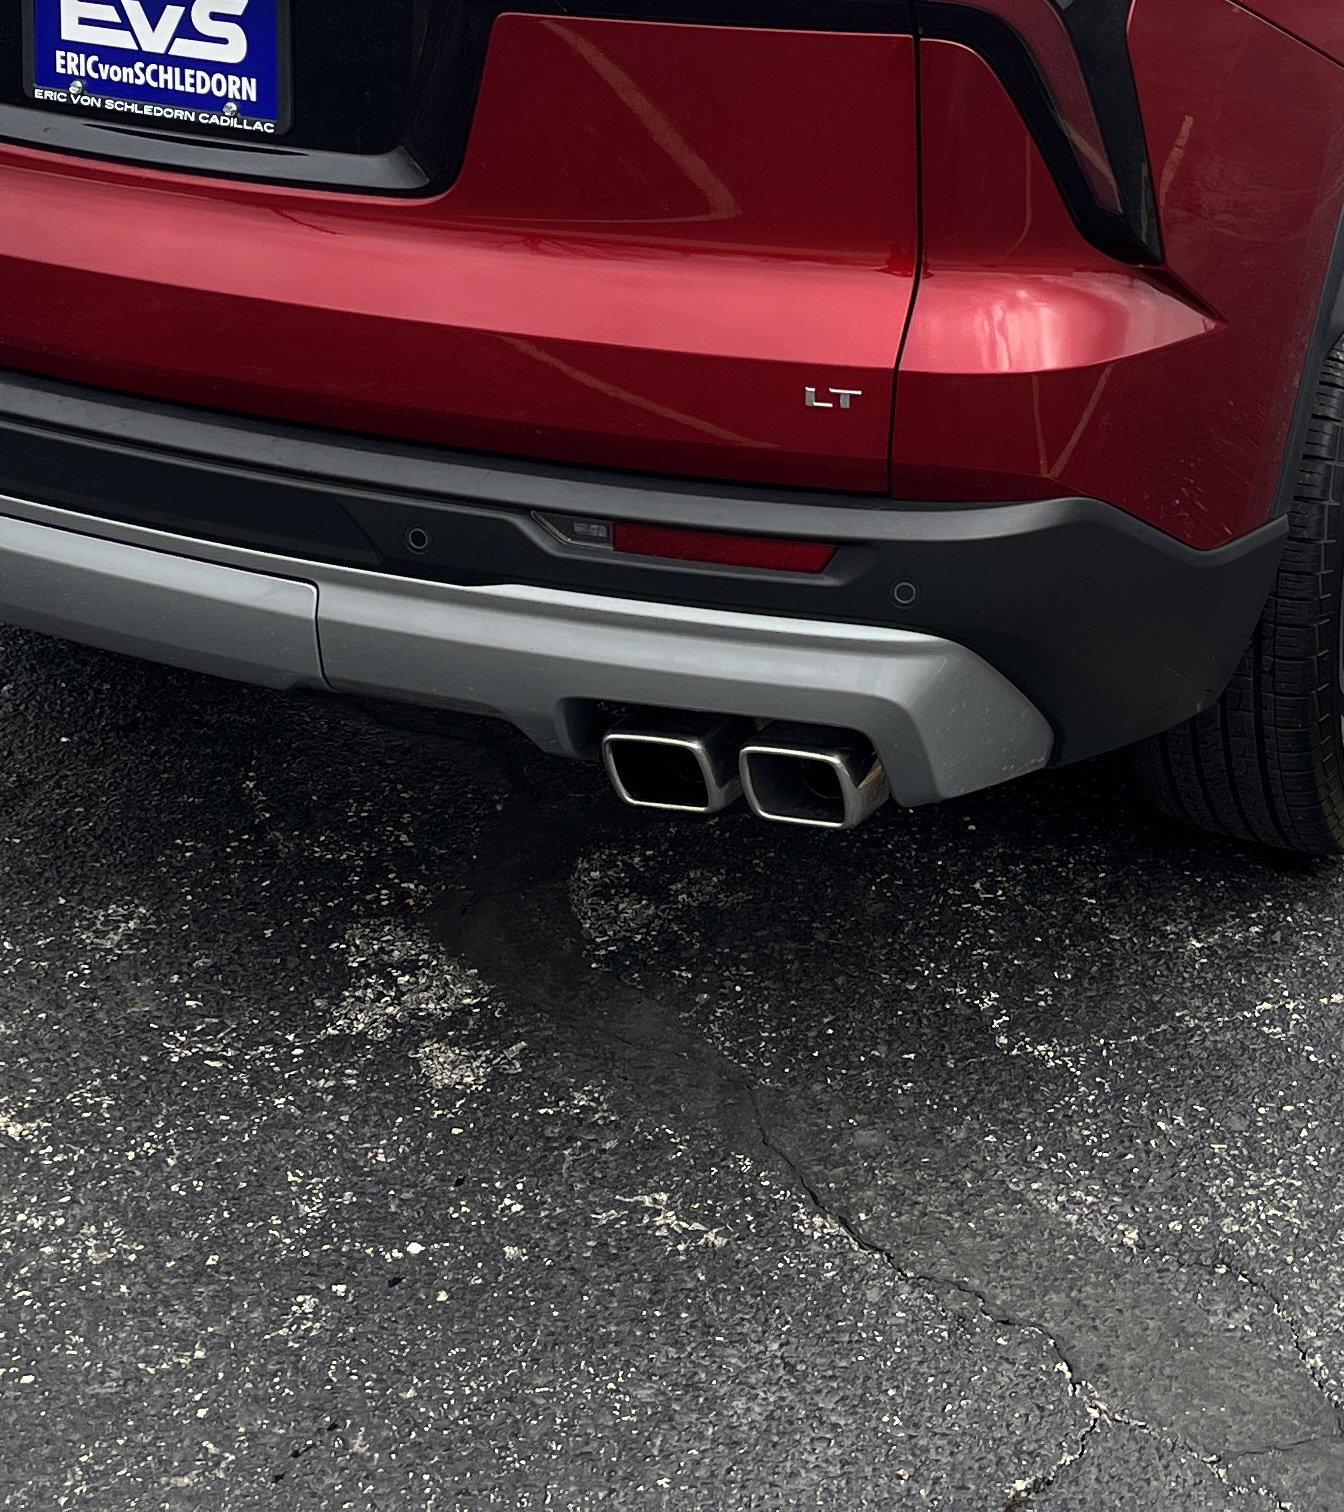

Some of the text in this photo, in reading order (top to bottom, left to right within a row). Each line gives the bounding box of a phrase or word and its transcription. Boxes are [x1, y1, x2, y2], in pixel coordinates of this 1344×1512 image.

[34, 89, 275, 134] ERIC VON SCHLEDORN CADILLAC
[804, 386, 863, 409] LT
